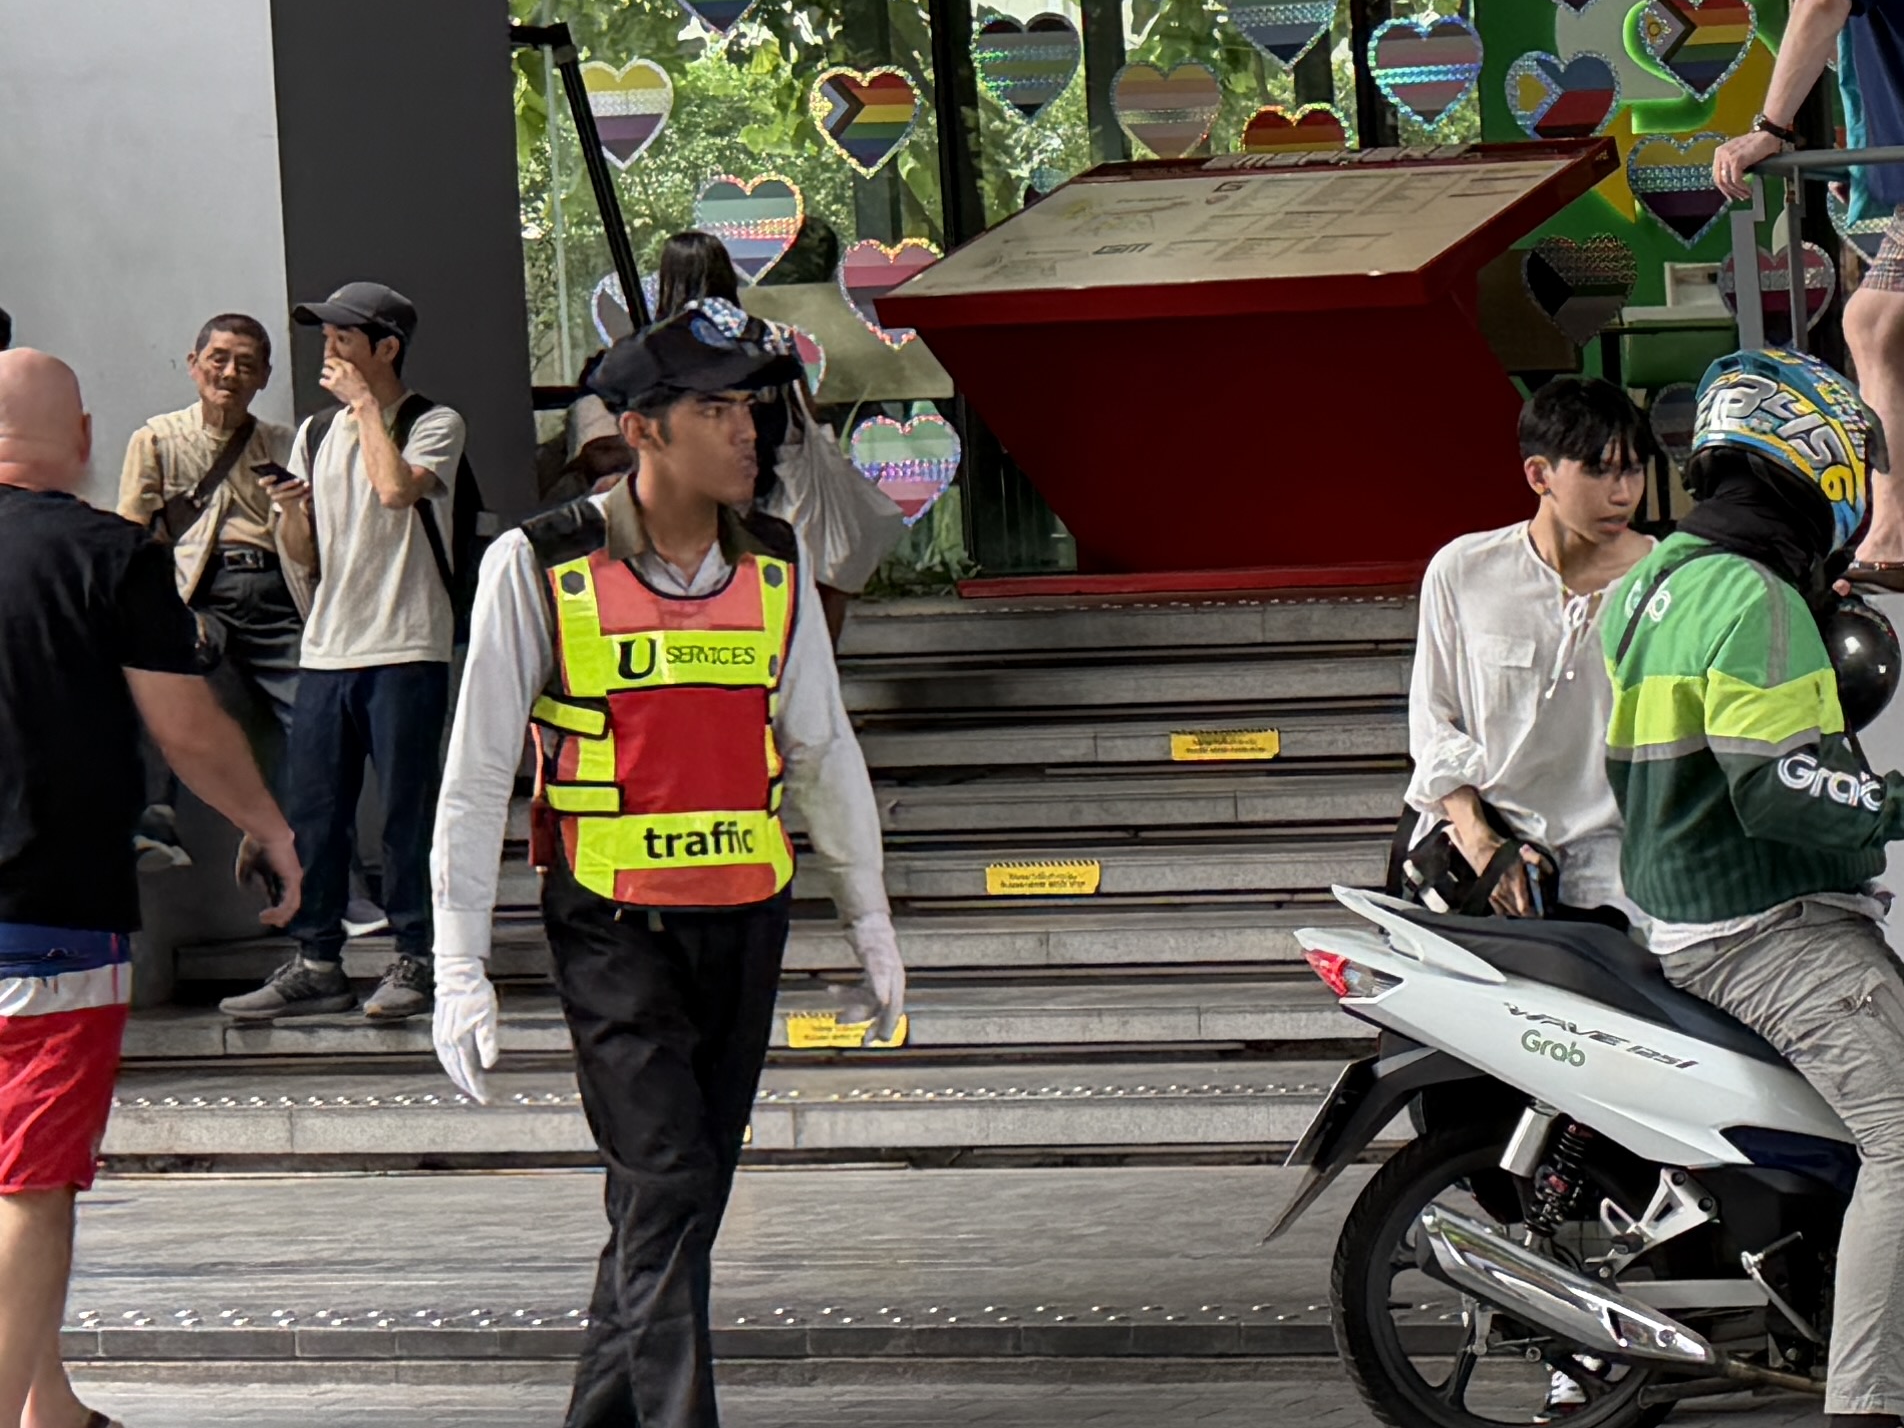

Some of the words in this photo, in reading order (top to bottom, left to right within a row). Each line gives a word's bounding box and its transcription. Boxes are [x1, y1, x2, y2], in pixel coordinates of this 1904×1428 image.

[617, 637, 657, 680] U
[665, 644, 757, 667] SERVICES
[643, 820, 755, 863] traffic
[1520, 1028, 1587, 1068] Grab
